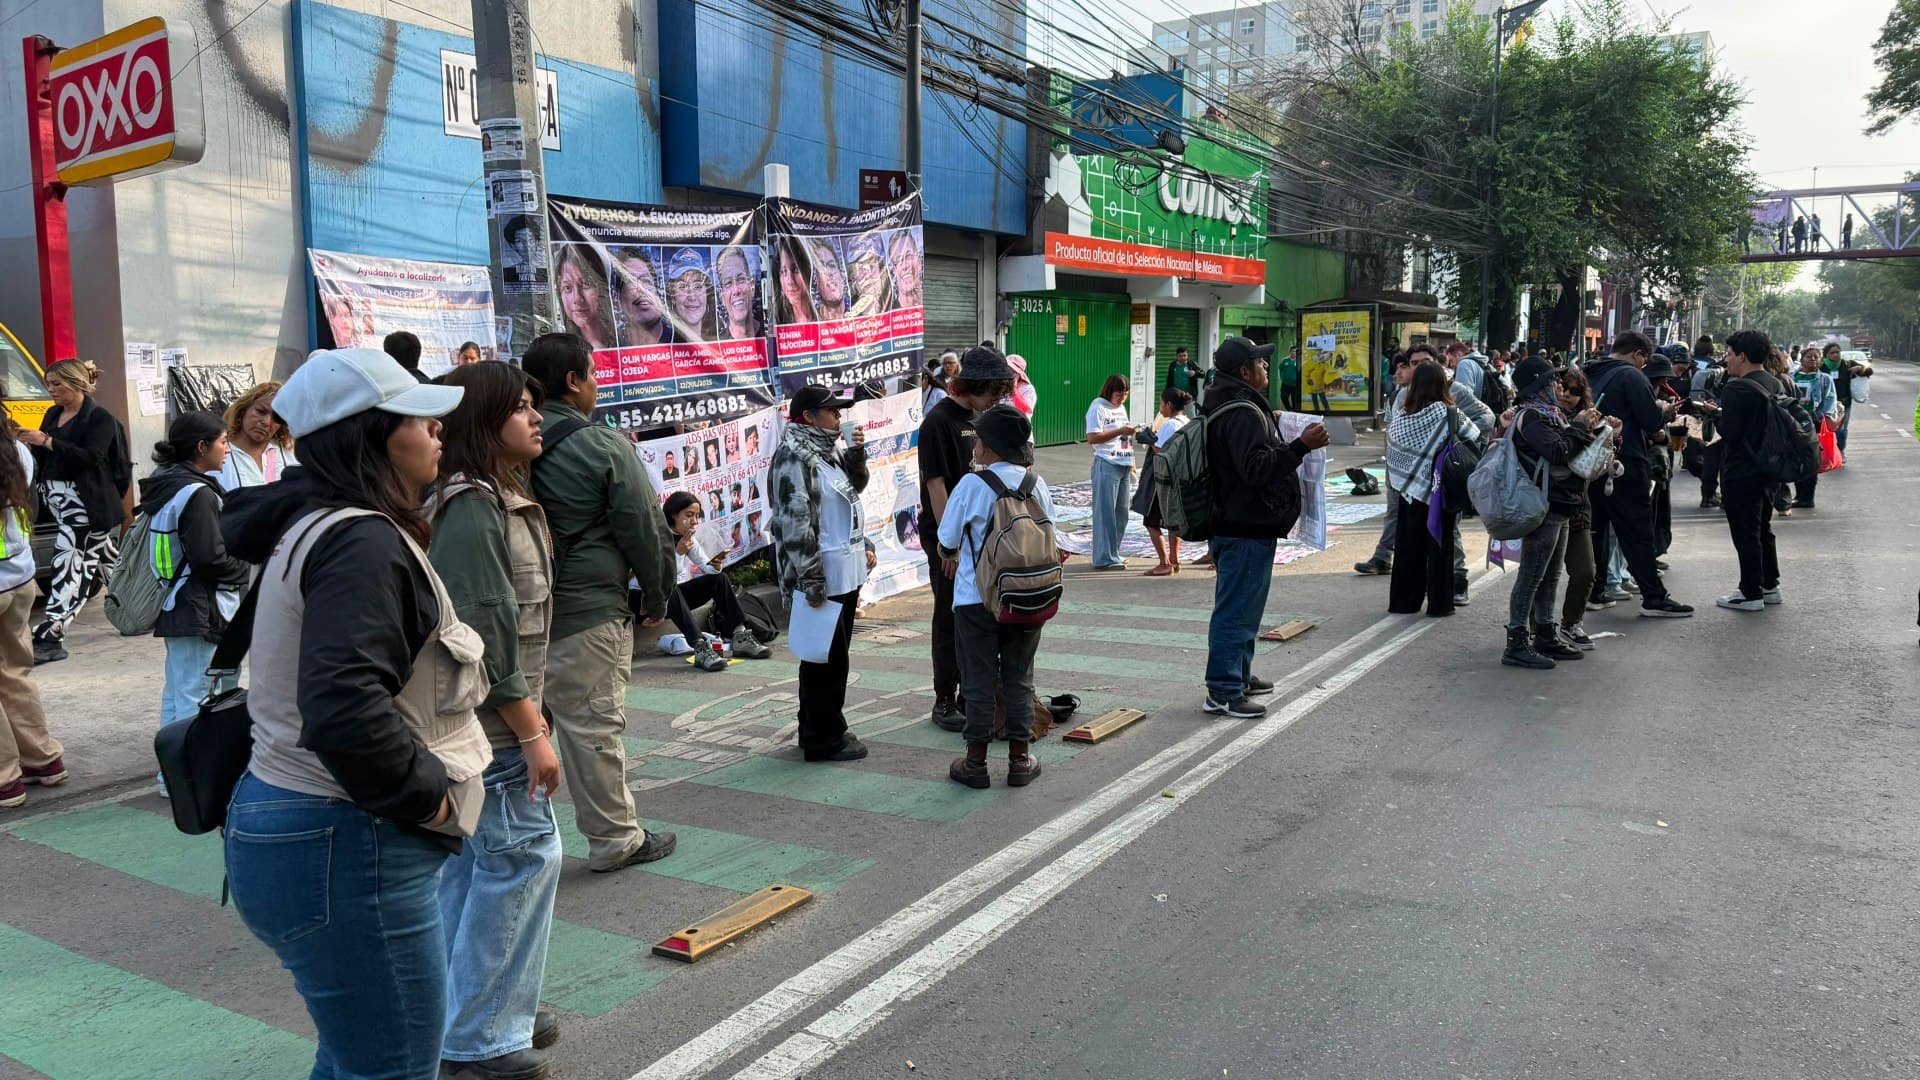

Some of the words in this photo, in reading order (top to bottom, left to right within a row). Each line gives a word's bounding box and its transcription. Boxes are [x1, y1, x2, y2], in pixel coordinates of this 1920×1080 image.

[57, 53, 163, 152] OXXO
[639, 210, 649, 224] A
[579, 225, 622, 237] Denuncia
[693, 229, 714, 239] sabes
[715, 230, 731, 240] algo.
[1055, 242, 1091, 261] Producto
[1092, 246, 1116, 264] oficial
[1116, 250, 1126, 265] de
[1126, 250, 1134, 266] la
[1134, 250, 1166, 269] Selección
[1166, 255, 1194, 271] Nacional
[1021, 299, 1043, 313] 3025
[1046, 300, 1052, 313] A
[641, 351, 671, 362] VARGAS
[622, 366, 649, 376] OJEDA
[816, 356, 910, 388] 55-423468883
[619, 394, 748, 429] 55-423468883
[703, 427, 717, 440] HAS
